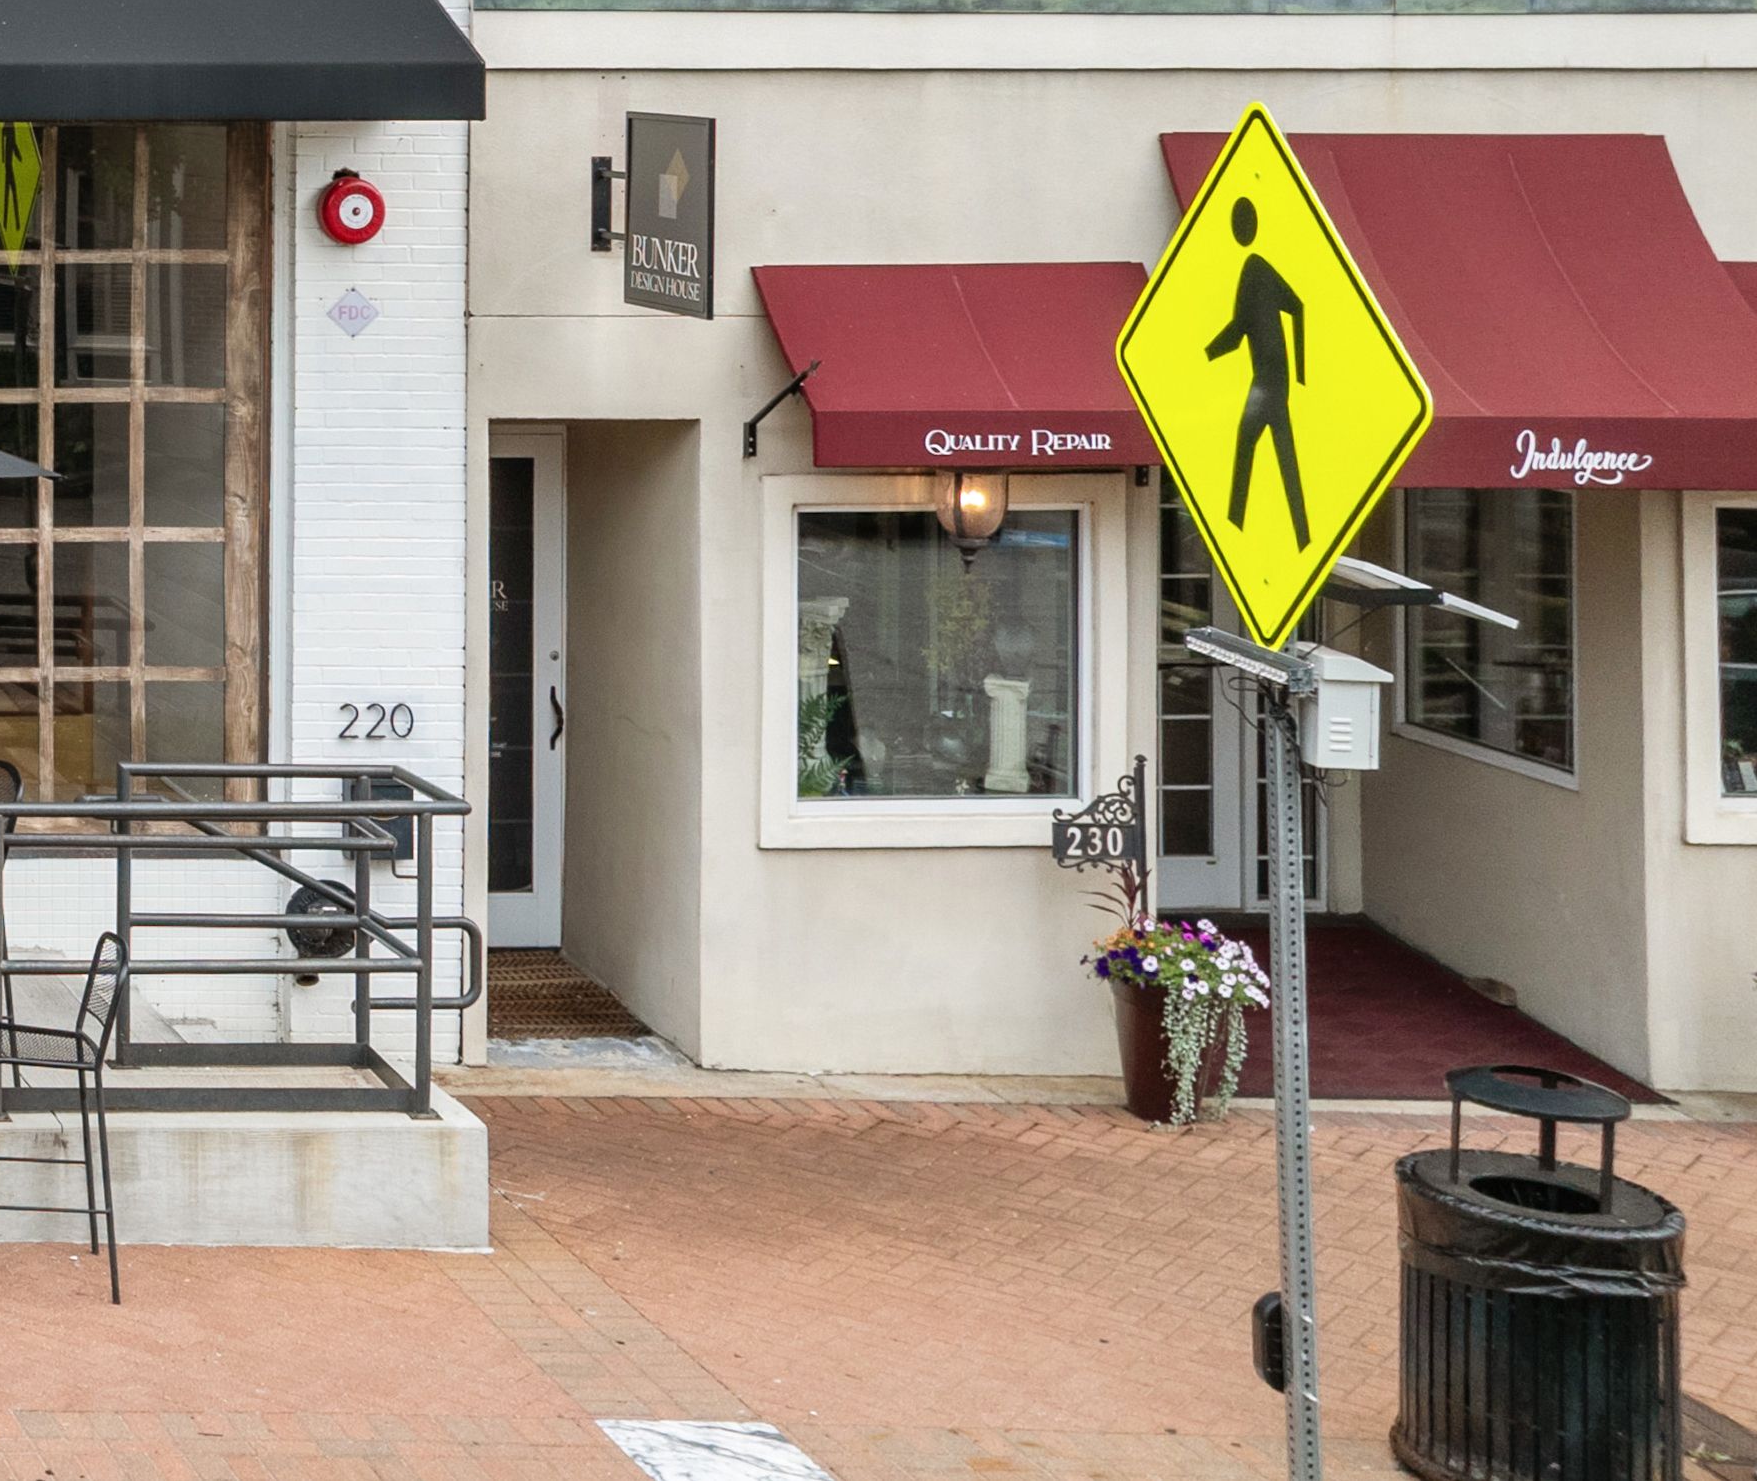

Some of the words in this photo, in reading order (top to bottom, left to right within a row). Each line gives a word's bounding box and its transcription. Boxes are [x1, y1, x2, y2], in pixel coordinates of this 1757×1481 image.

[632, 234, 701, 278] BUNKER
[631, 271, 665, 293] DESIGN
[665, 276, 701, 301] HOUSE
[338, 305, 371, 320] FDC
[925, 429, 1021, 456] QUALITY
[1031, 429, 1112, 456] REPAIR
[1510, 429, 1653, 485] Indulgence
[339, 704, 413, 739] 220
[1067, 827, 1123, 856] 230
